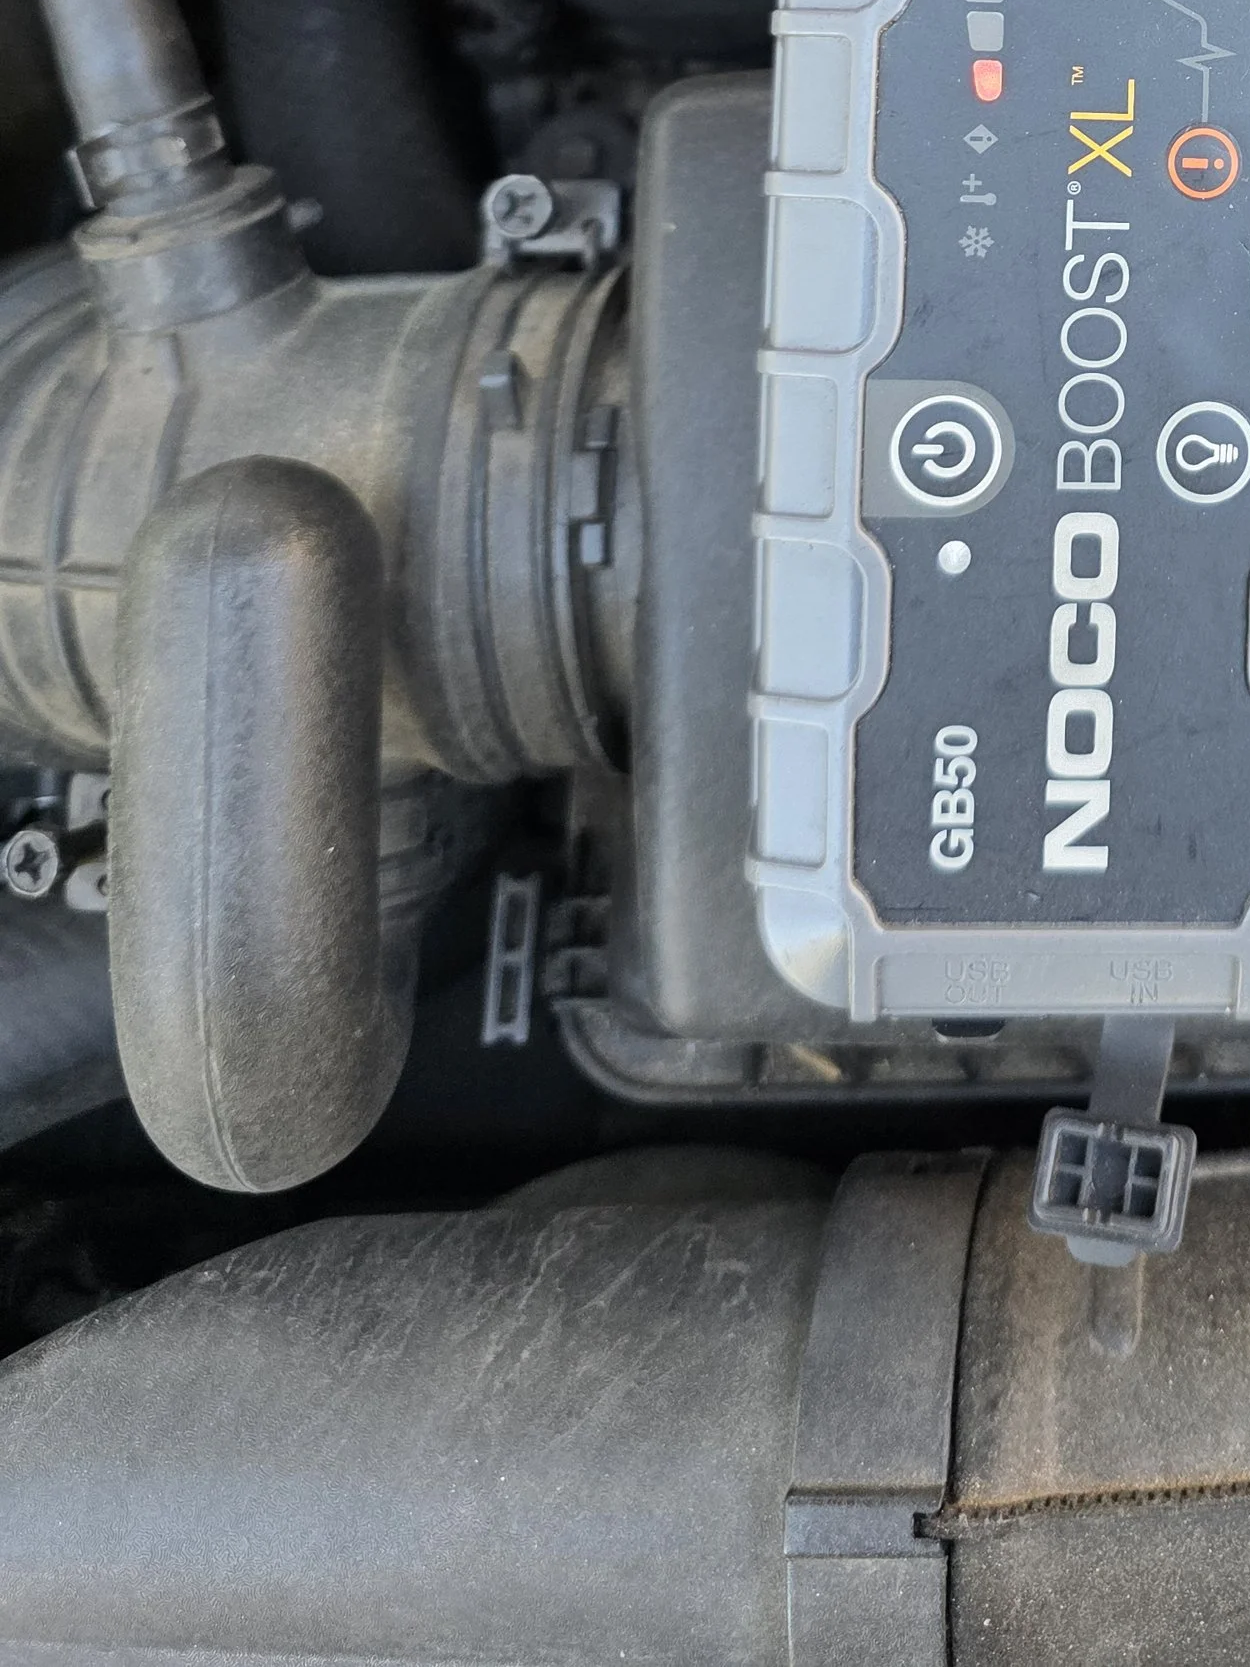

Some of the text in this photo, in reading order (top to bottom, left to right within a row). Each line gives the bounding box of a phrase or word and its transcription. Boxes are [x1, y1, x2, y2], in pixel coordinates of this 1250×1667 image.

[1042, 511, 1118, 874] NOCO
[930, 725, 978, 872] GB50
[944, 960, 1010, 982] USB
[1109, 960, 1173, 982] USB
[944, 985, 1007, 1005] OUT
[1130, 983, 1158, 1005] IN
